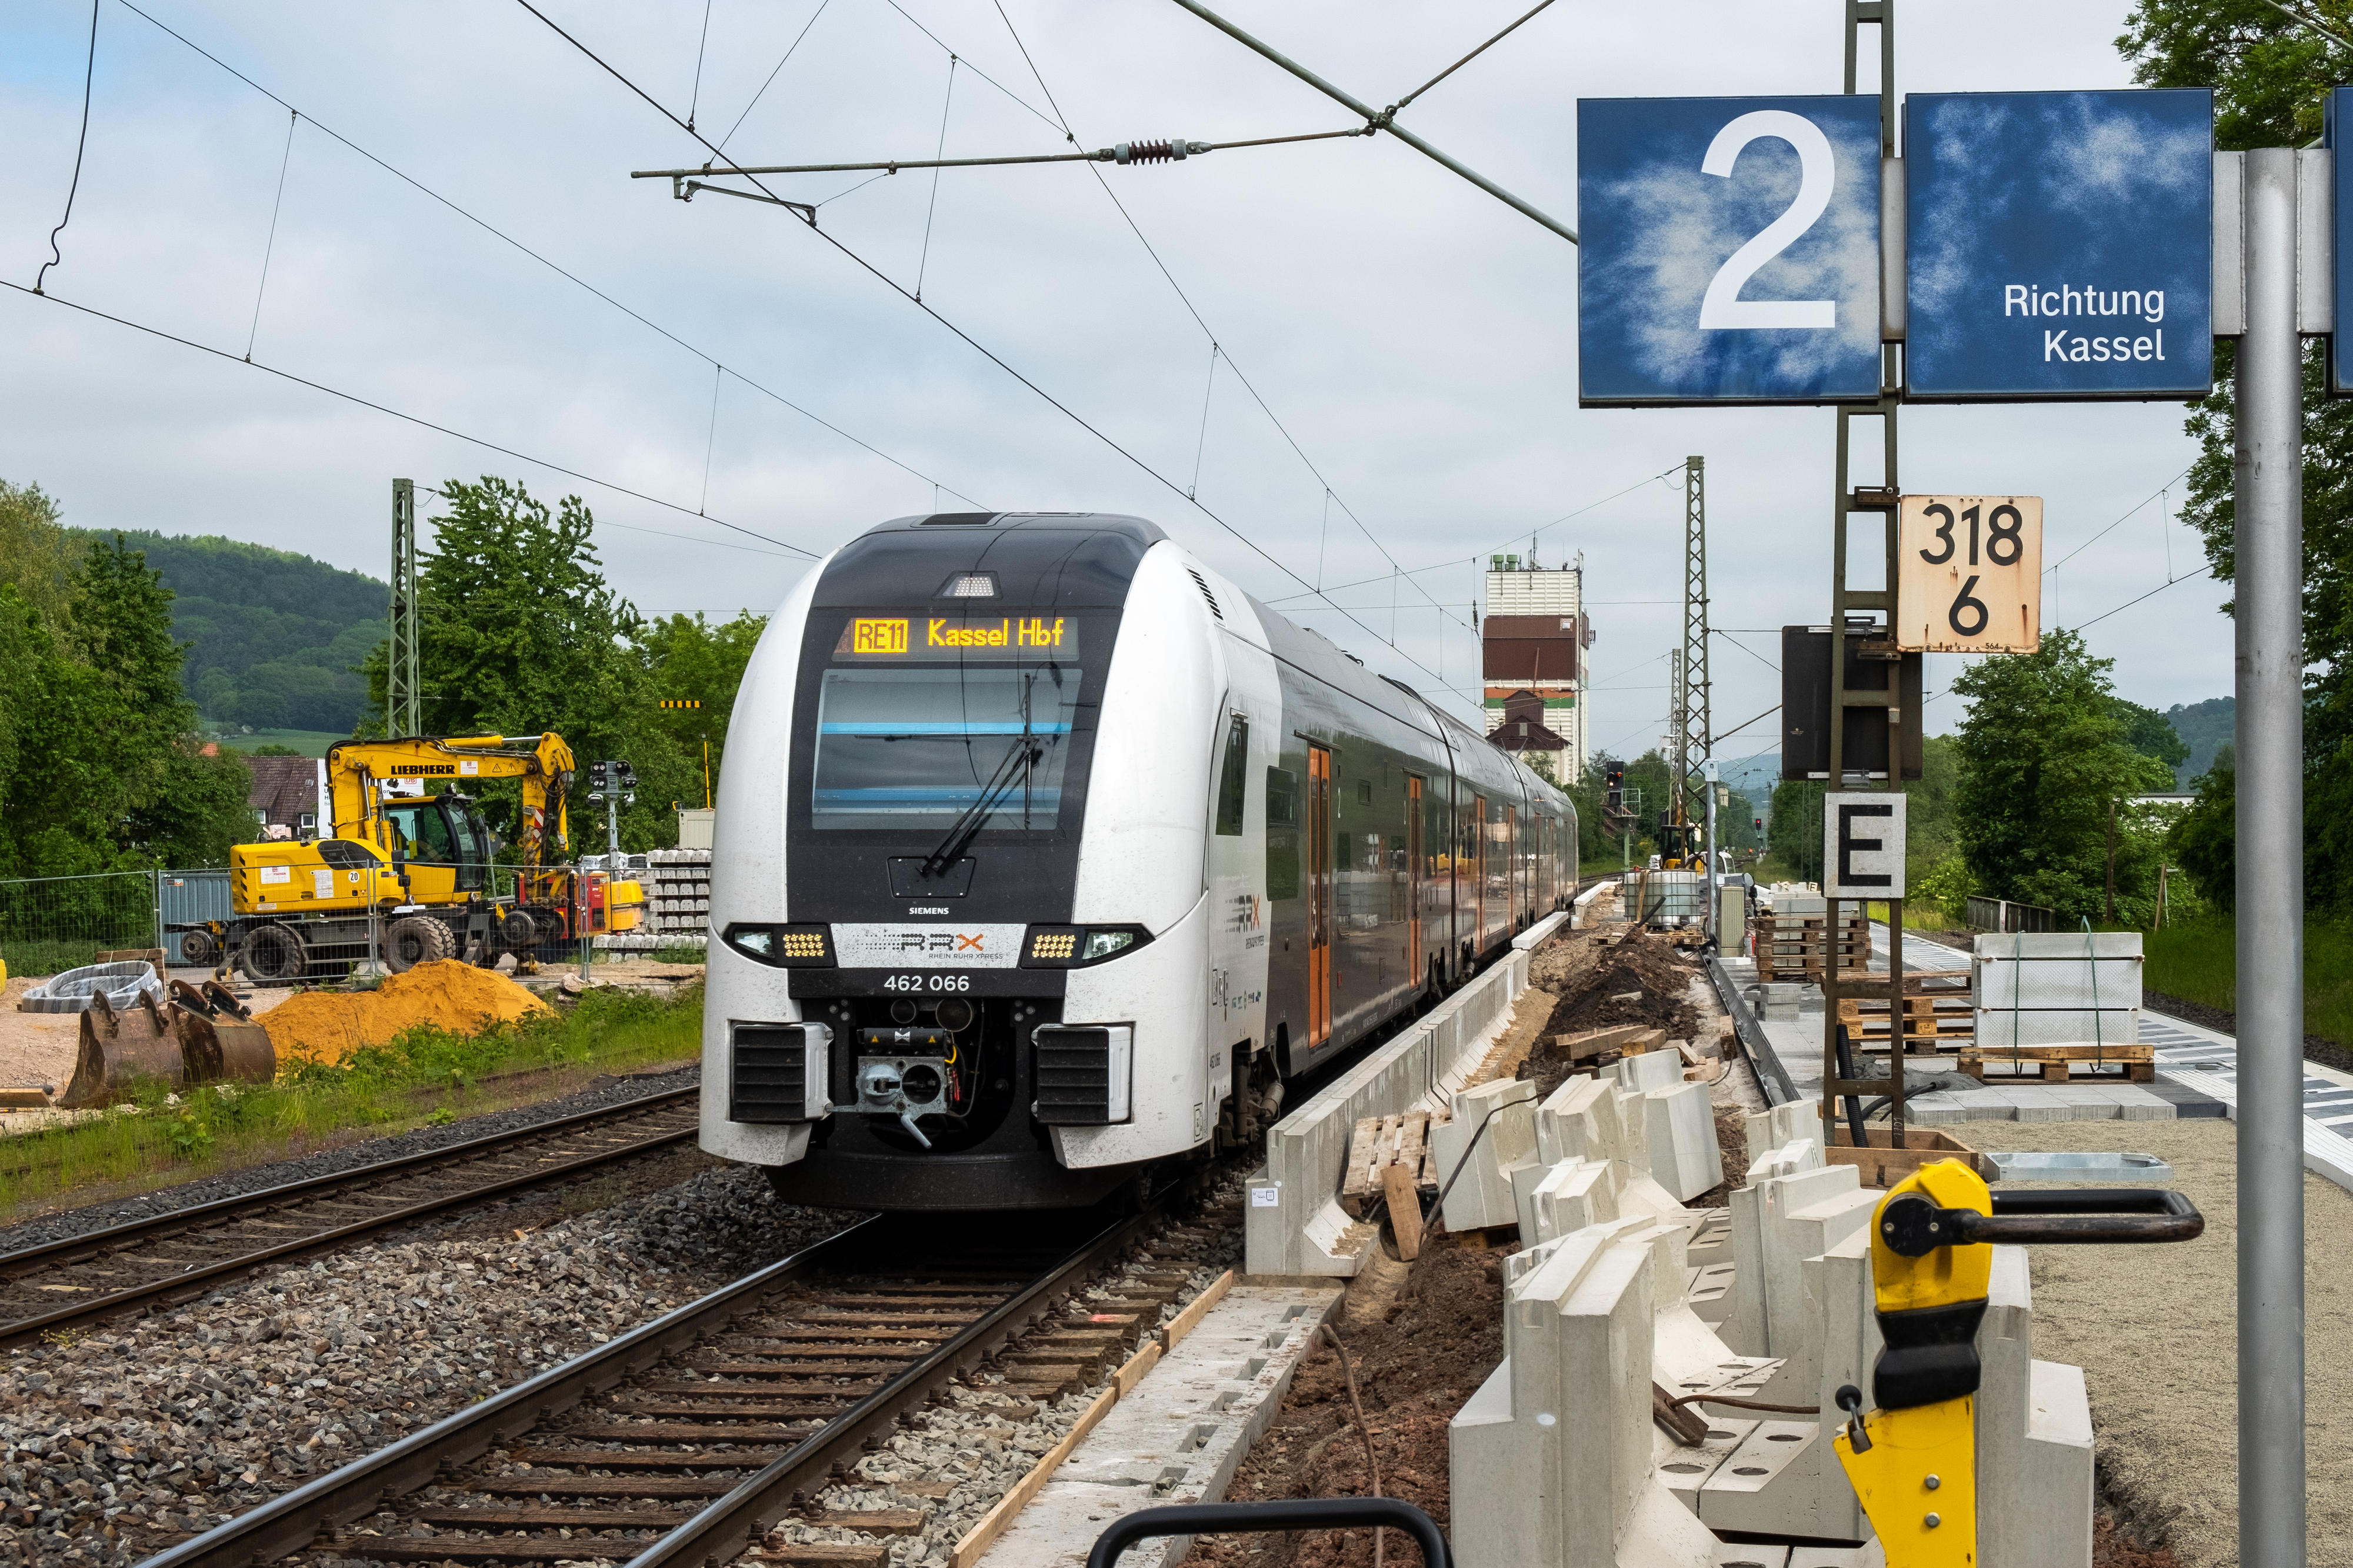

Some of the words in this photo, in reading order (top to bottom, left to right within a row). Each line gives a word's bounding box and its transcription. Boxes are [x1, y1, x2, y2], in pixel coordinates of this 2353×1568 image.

[1699, 109, 1835, 329] 2
[2005, 284, 2164, 323] Richtung
[2044, 329, 2165, 362] Kassel
[1919, 503, 2024, 566] 318
[1948, 575, 1989, 636] 6
[859, 622, 905, 650] RE11
[928, 618, 1009, 646] Kassel
[1018, 617, 1064, 646] Hbf
[391, 764, 455, 775] LIEBHERR
[1838, 804, 1893, 886] E
[349, 872, 358, 882] 20
[900, 933, 984, 952] RRX
[884, 975, 923, 991] 462
[929, 975, 970, 992] 066
